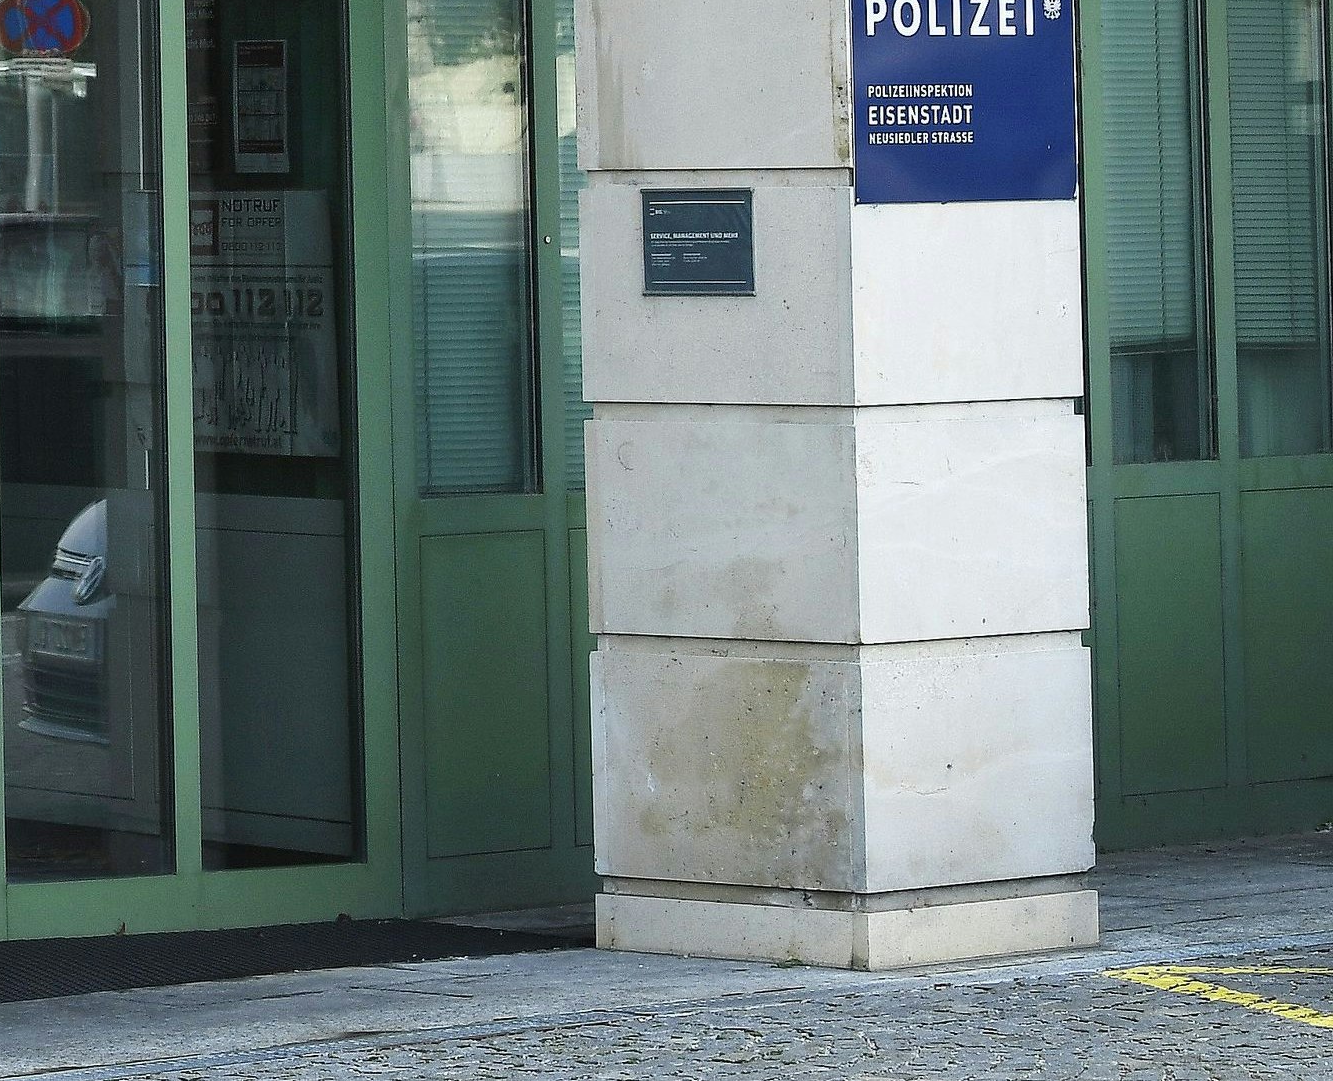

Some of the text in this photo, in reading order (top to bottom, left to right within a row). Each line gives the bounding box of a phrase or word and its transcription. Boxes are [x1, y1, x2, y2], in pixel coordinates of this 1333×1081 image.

[868, 84, 973, 98] POLIZEIINSPEKTION
[868, 104, 973, 125] EISENSTADT
[869, 131, 974, 145] NEUSIEDLER STRASSE
[221, 199, 281, 212] NOTRUF
